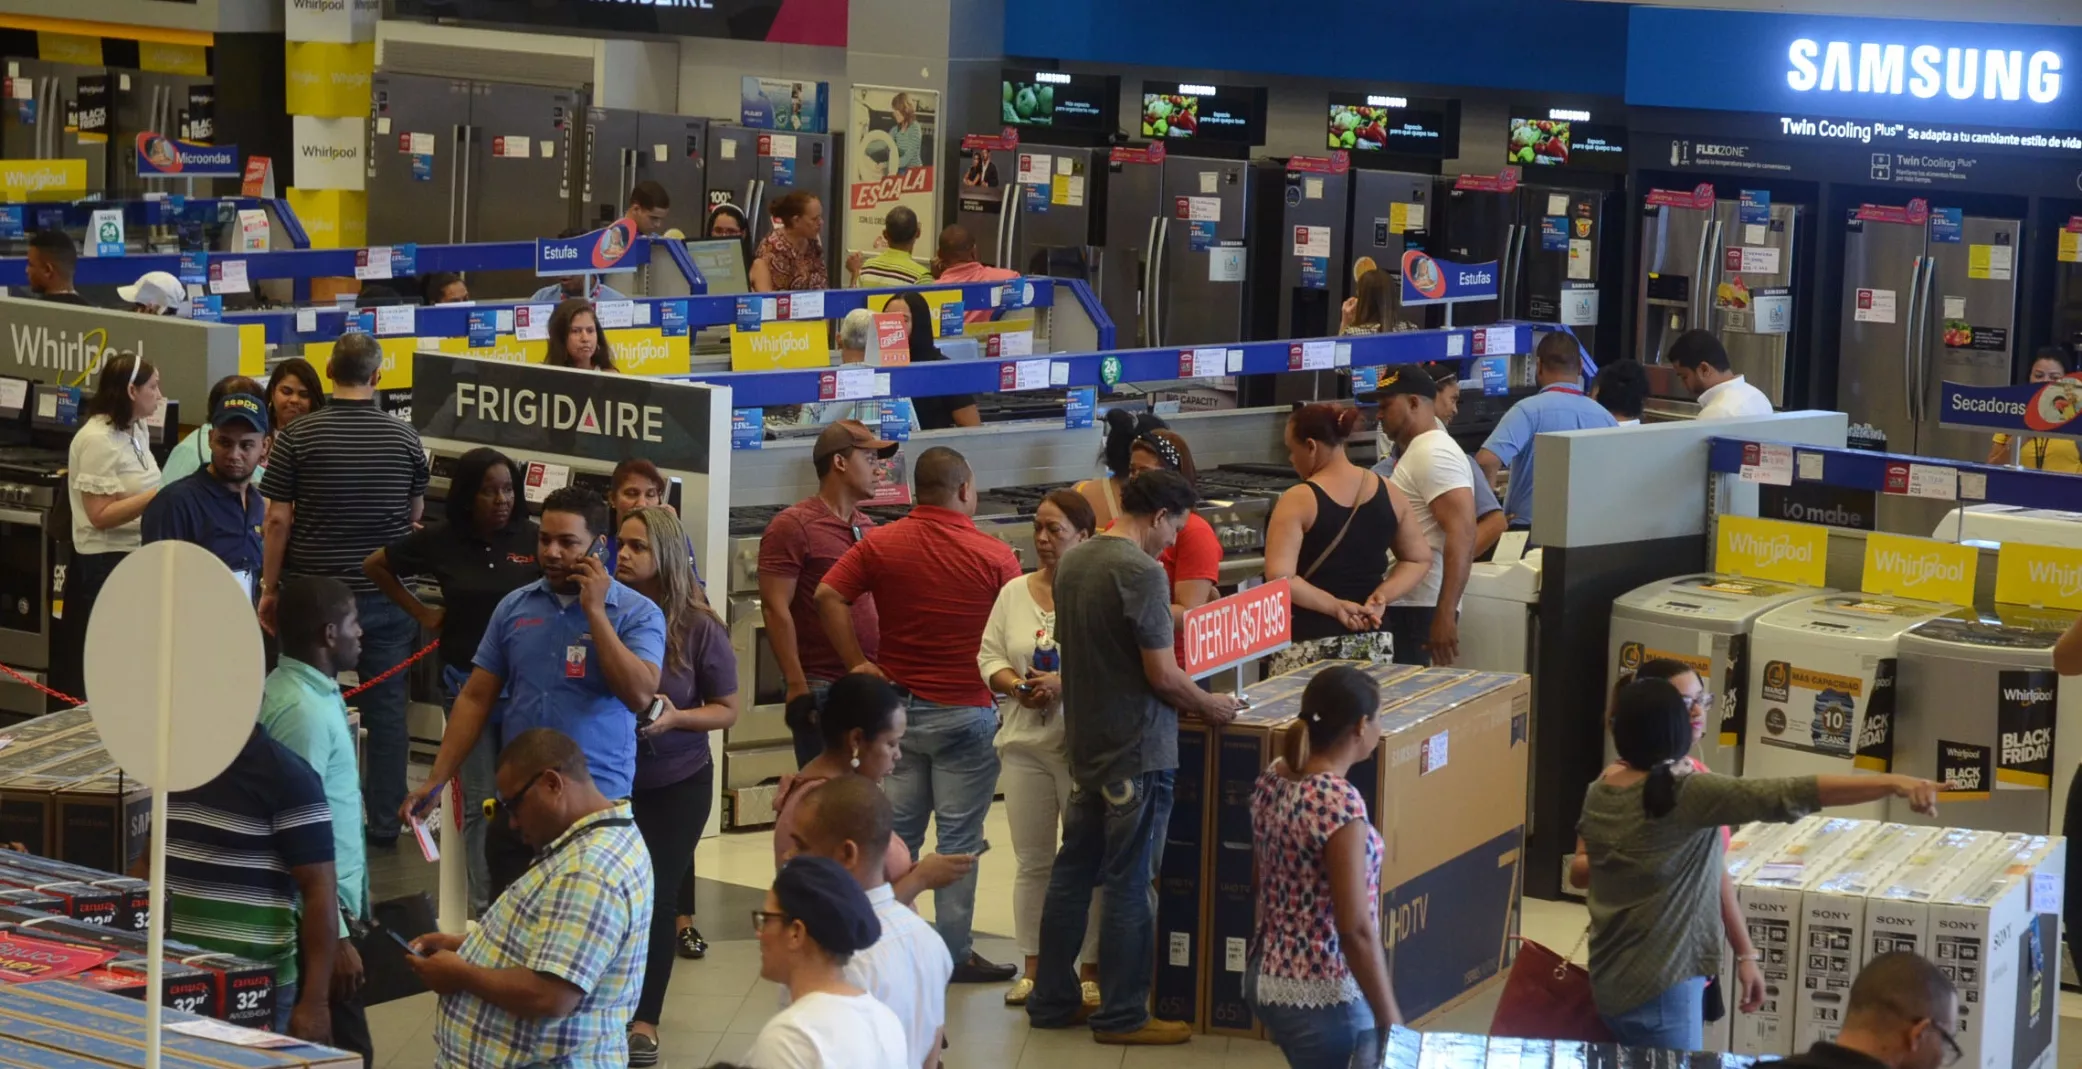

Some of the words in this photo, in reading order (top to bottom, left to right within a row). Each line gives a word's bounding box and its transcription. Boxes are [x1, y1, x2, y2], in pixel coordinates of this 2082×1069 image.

[1036, 72, 1071, 84] SAMSUNG
[1787, 39, 2061, 103] SAMSUNG
[1179, 84, 1216, 96] SAMSUNG
[1367, 94, 1407, 108] SAMSUNG
[80, 107, 105, 118] BLACK
[1549, 109, 1591, 122] SAMSUNG
[80, 116, 105, 129] FRIDAY
[191, 118, 212, 132] BLAC
[1780, 117, 1816, 136] Twin
[1819, 120, 1872, 144] Cooling
[1908, 128, 1919, 140] Se
[1920, 129, 1952, 143] adapta
[1952, 132, 1959, 142] a
[1960, 131, 1970, 143] tu
[1972, 132, 2020, 146] cambiante
[2021, 134, 2048, 148] estilo
[2048, 136, 2060, 148] de
[2062, 137, 2082, 150] vida
[176, 152, 231, 165] Microondas
[302, 145, 357, 160] Whirlpool
[1896, 155, 1920, 166] Twin
[1921, 156, 1956, 171] Cooling
[4, 170, 67, 191] Whirlpool
[856, 167, 925, 207] ESCALA
[102, 225, 117, 236] 24
[543, 245, 578, 260] Estufas
[1459, 271, 1492, 286] Estufas
[750, 334, 810, 358] Whirlpool
[10, 322, 144, 387] Whirlpo
[1104, 360, 1117, 374] 24
[1180, 394, 1219, 407] CAPACITY
[1952, 393, 2026, 416] Secadoras
[456, 382, 663, 443] FRIGIDAIRE
[1806, 505, 1861, 526] mabe
[1728, 530, 1812, 565] Whirlpool
[1874, 548, 1964, 584] Whirlpool
[1188, 603, 1241, 666] OFERTA
[1792, 671, 1810, 682] MÁS
[1812, 676, 1859, 690] CAPACIDAD
[1764, 686, 1787, 697] MARCA
[2004, 688, 2053, 704] Whirlpool
[1824, 707, 1843, 729] 10
[1820, 734, 1846, 745] JEANS
[2002, 727, 2051, 749] BLACK
[1946, 747, 1980, 760] Whirlpool
[2002, 743, 2050, 765] FRIDAY
[1945, 767, 1981, 779] BLACK
[80, 902, 116, 913] aiwa
[1748, 901, 1788, 913] SONY
[1812, 909, 1851, 921] SONY
[1876, 915, 1916, 928] SONY
[1938, 920, 1980, 931] SONY
[169, 982, 209, 996] aiwa
[233, 976, 271, 988] aiwa
